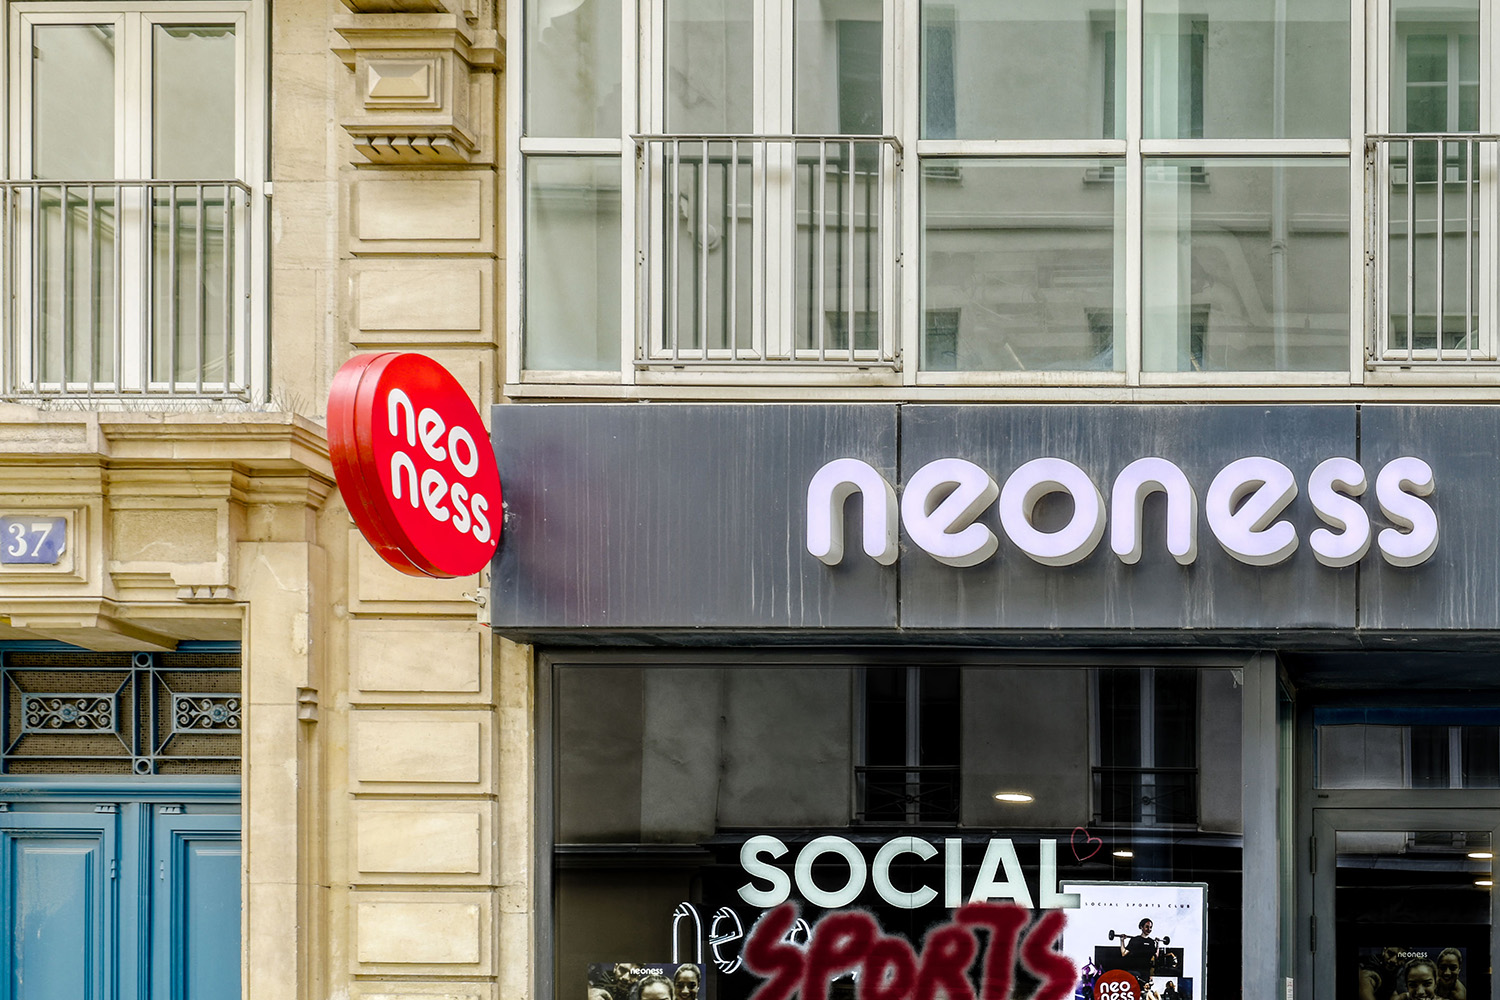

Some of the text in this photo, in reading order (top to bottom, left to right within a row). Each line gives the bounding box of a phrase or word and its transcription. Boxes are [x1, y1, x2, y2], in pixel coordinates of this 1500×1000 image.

[388, 388, 479, 478] neo
[391, 451, 491, 543] ness
[806, 456, 1440, 567] neoness
[8, 523, 53, 557] 37
[737, 834, 1081, 909] SOCIAL
[630, 967, 664, 975] neoness
[1100, 981, 1131, 993] neo
